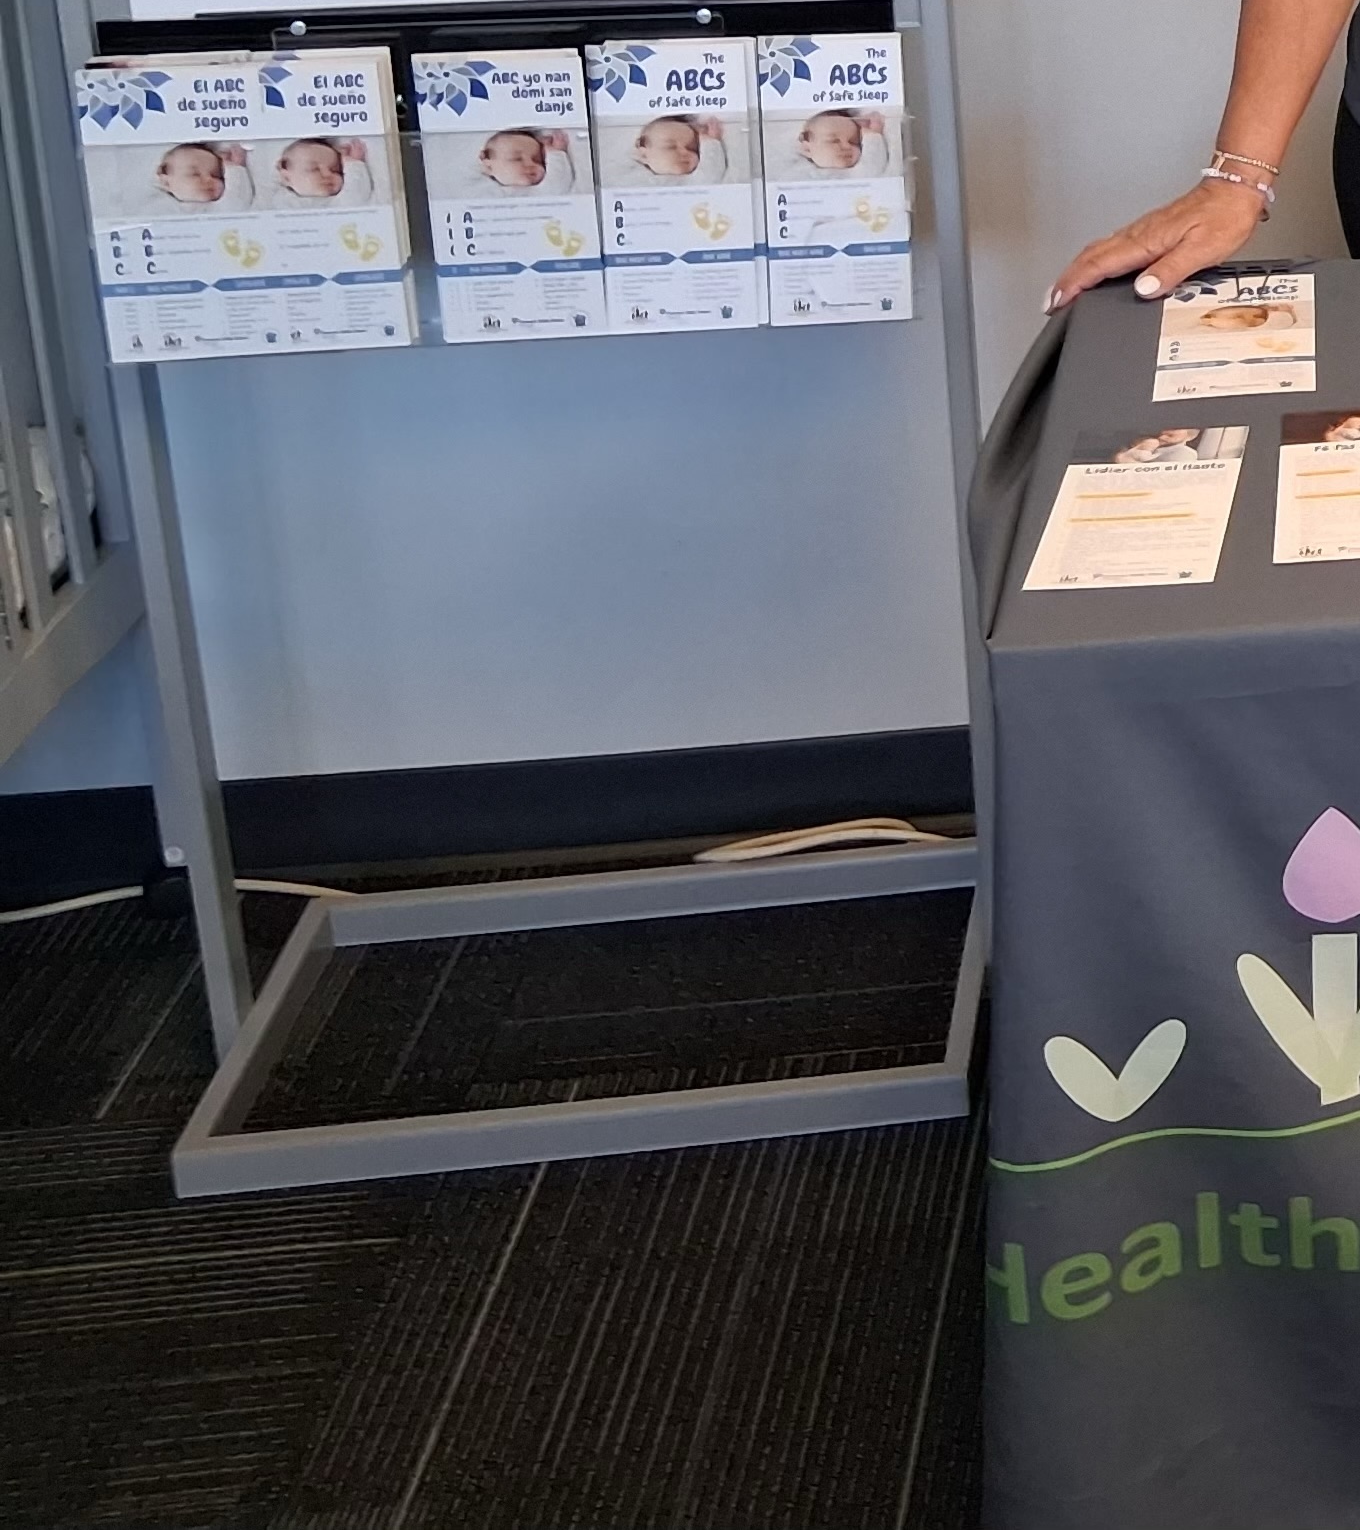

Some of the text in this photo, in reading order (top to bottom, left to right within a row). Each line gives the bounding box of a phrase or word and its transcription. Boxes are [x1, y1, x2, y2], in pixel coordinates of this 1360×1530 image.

[703, 53, 725, 64] The
[866, 47, 887, 59] The
[313, 73, 364, 89] El ABC
[491, 71, 571, 87] ABC yo nan
[665, 67, 726, 92] ABCs
[829, 62, 888, 86] ABCs
[193, 77, 245, 93] El ABC
[549, 86, 573, 98] san
[177, 96, 247, 111] de sueño
[297, 91, 366, 107] de sueño
[648, 94, 728, 110] of Safe Sleep
[812, 88, 889, 104] of Safe Sleep
[534, 99, 575, 115] danje
[194, 115, 249, 132] seguro
[313, 110, 368, 128] seguro
